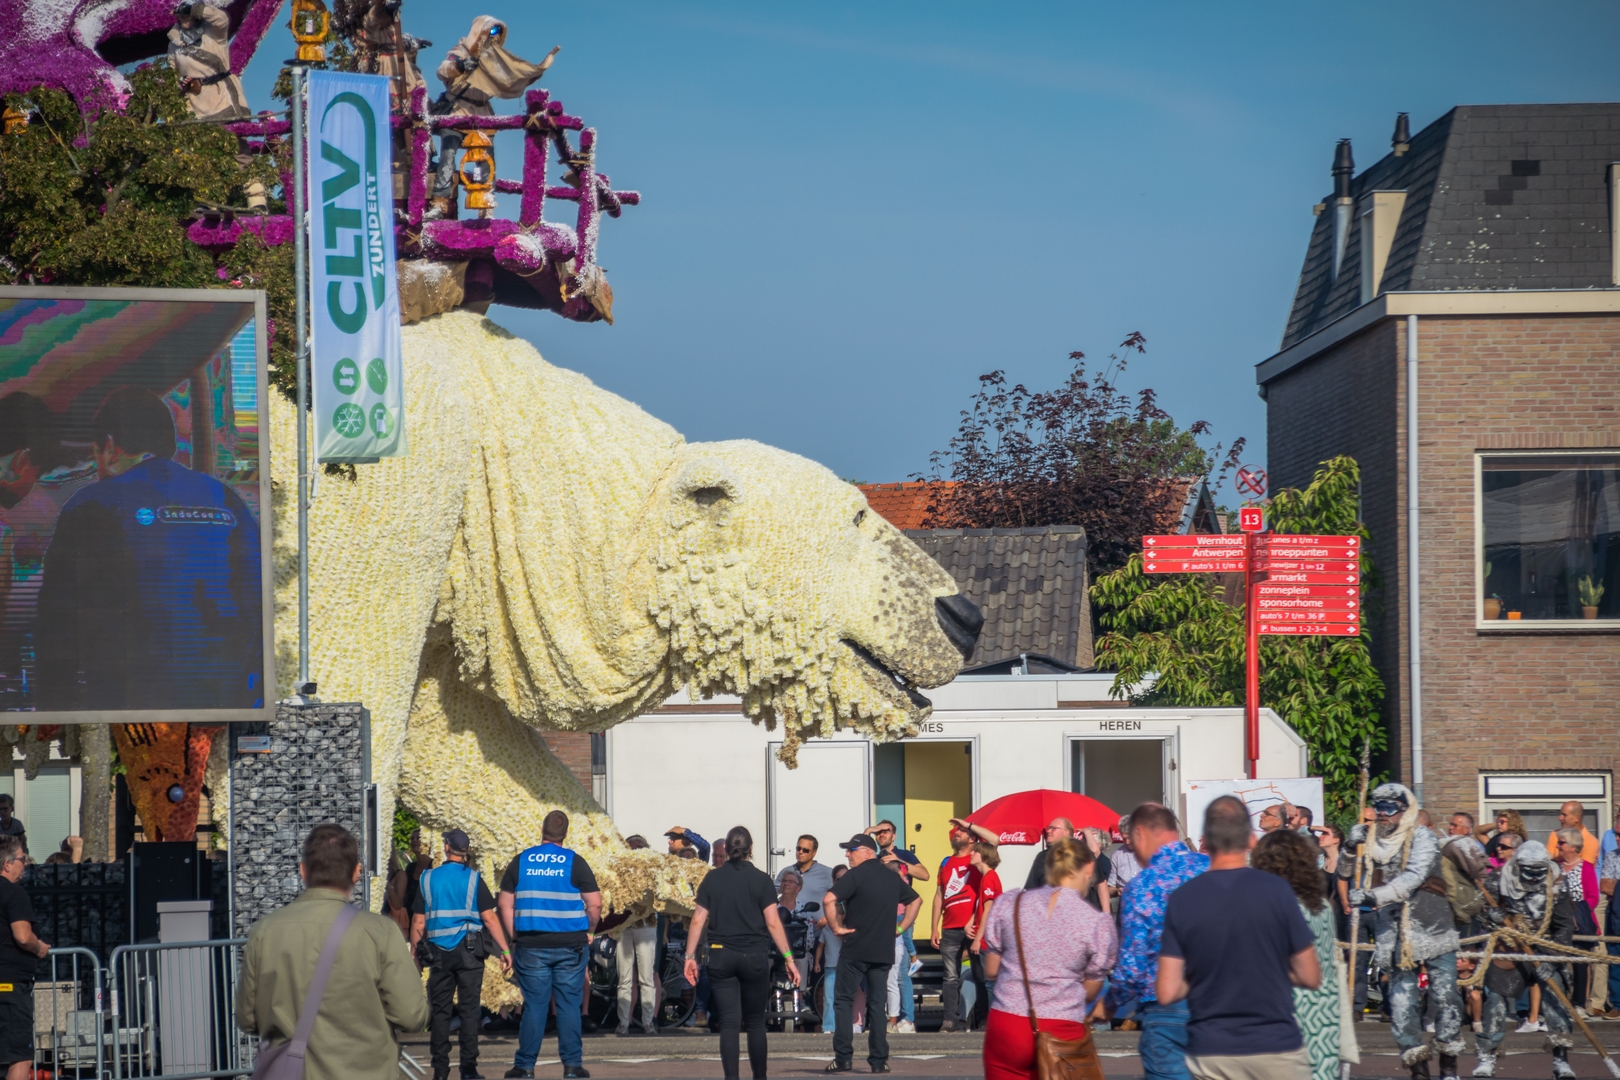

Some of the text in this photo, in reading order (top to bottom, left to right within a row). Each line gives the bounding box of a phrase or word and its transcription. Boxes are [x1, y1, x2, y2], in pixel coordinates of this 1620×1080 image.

[366, 171, 386, 278] ZUNDERT
[321, 139, 367, 335] CLTV
[1243, 514, 1260, 525] 13
[1196, 536, 1243, 545] Wernhout
[1192, 548, 1243, 558] Antwerpen
[1191, 562, 1214, 570] auto's
[1259, 586, 1310, 596] zonneplein
[1259, 599, 1324, 608] sponsorhome
[1291, 612, 1305, 620] t/m
[919, 722, 944, 733] MES
[1099, 721, 1142, 731] HEREN
[528, 853, 566, 863] corso
[526, 867, 564, 877] zundert
